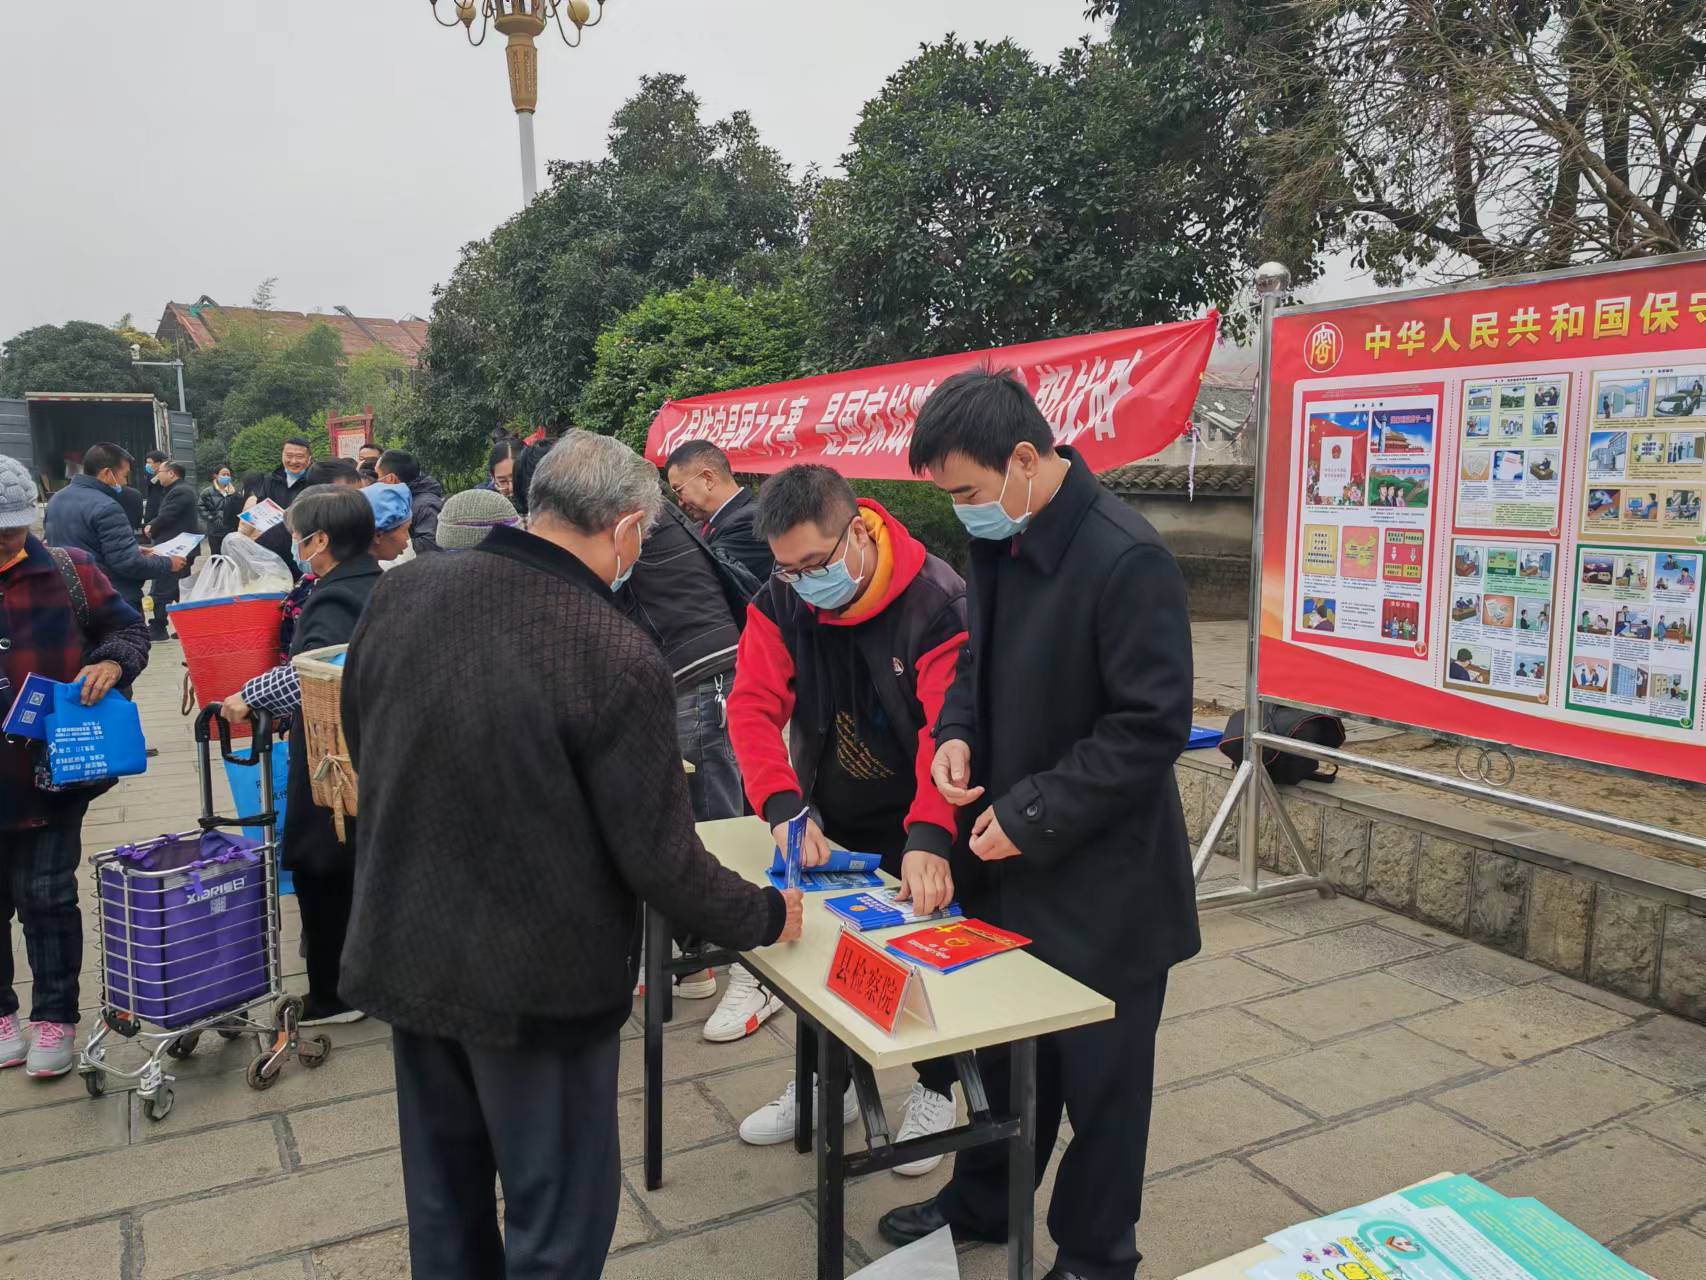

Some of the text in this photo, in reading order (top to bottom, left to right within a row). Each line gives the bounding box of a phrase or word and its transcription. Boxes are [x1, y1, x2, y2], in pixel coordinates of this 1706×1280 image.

[657, 395, 809, 457] 人民防空是国之大事
